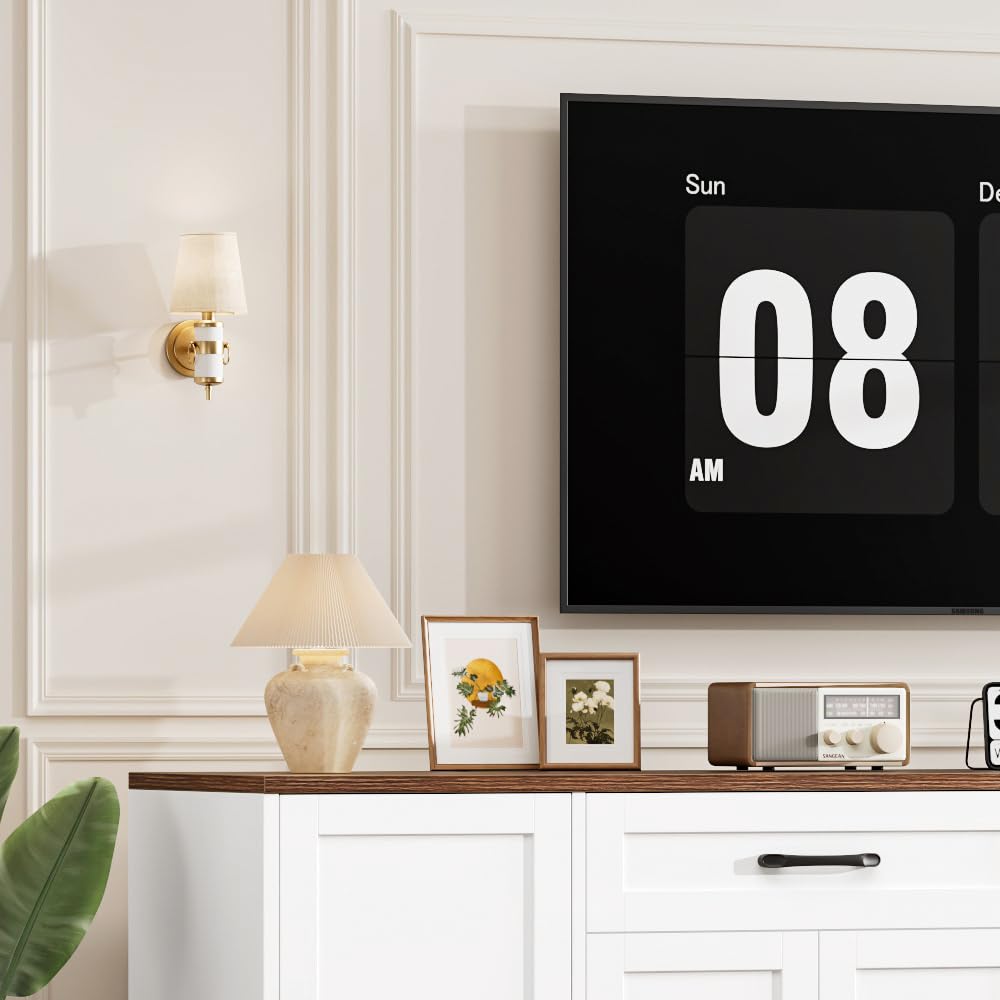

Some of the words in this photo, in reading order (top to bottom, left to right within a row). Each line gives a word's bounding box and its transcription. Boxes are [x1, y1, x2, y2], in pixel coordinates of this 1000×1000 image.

[685, 173, 726, 196] Sun
[718, 268, 920, 450] 08
[689, 457, 724, 483] AM
